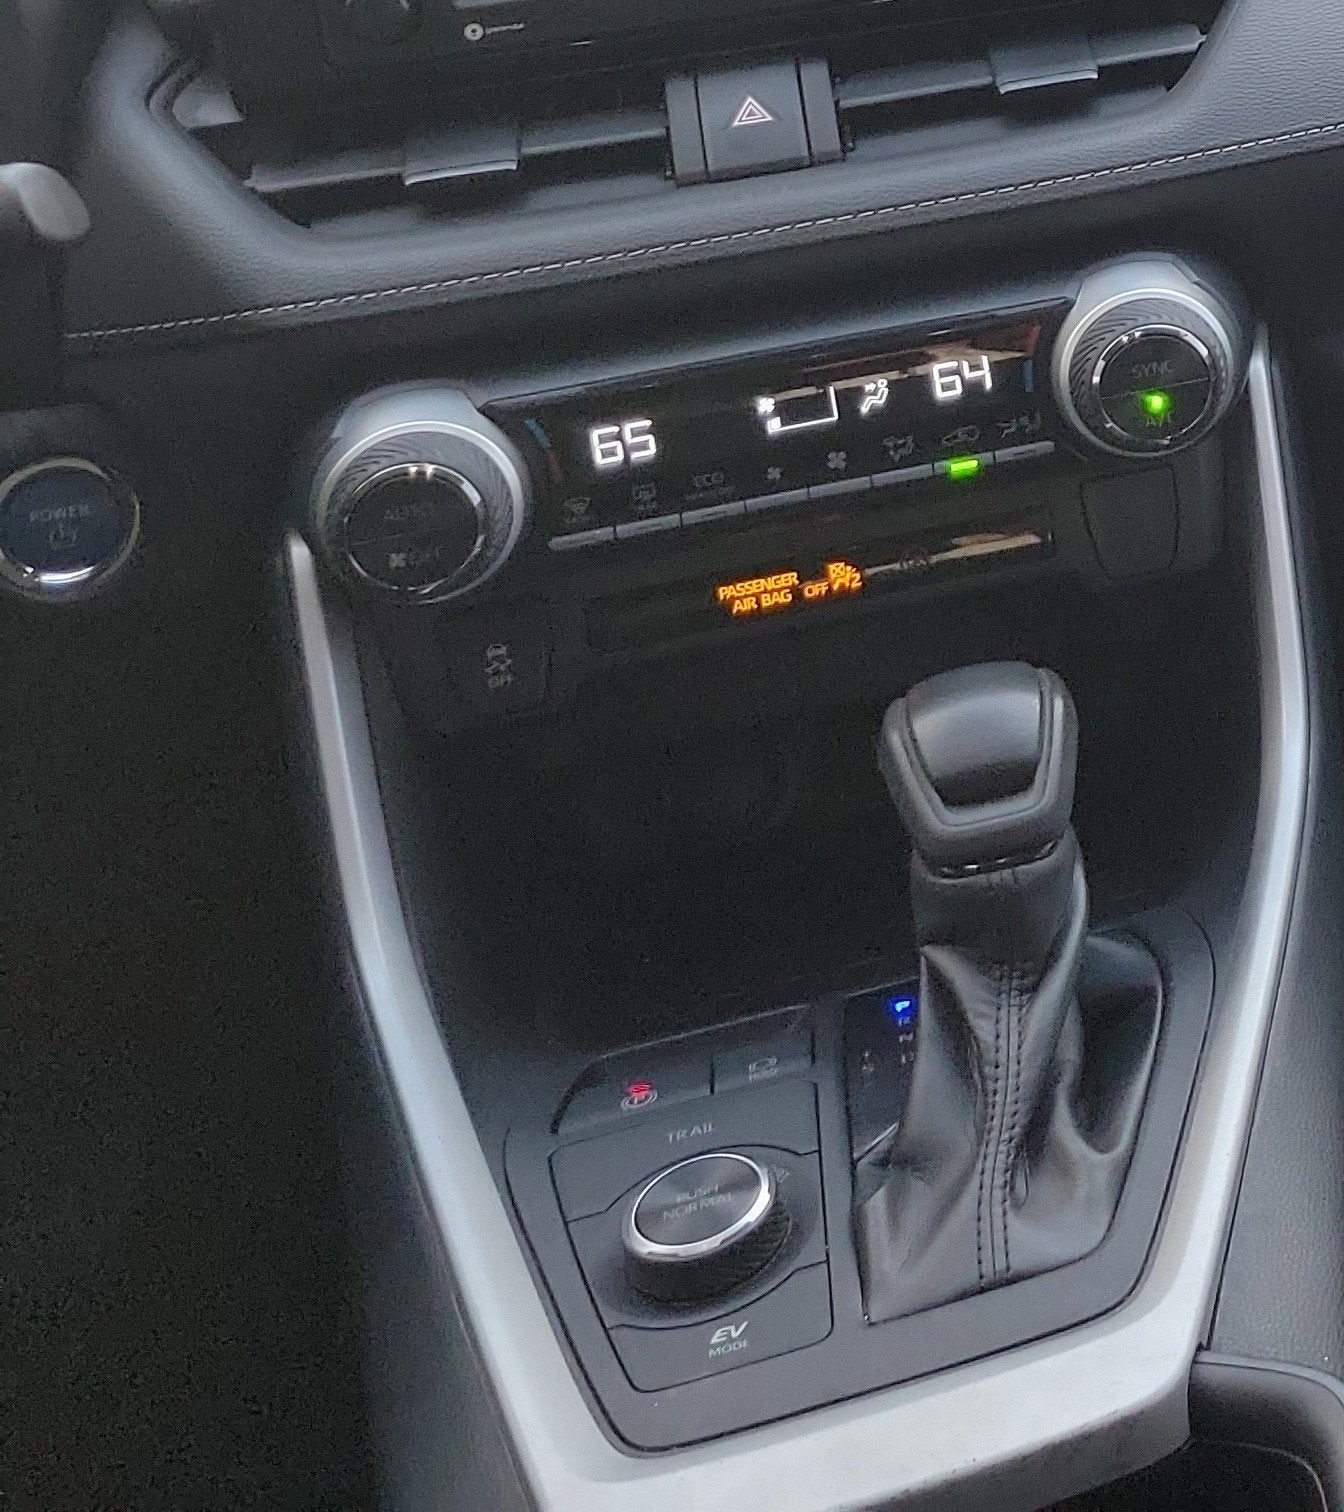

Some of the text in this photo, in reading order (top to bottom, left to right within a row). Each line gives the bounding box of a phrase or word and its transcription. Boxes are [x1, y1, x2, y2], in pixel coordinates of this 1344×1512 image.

[931, 355, 992, 400] 64
[1131, 359, 1174, 379] SYNC
[591, 418, 657, 467] 65
[718, 571, 800, 603] PASSENGER
[732, 582, 830, 615] AIR BAG OFF
[709, 1319, 749, 1345] EV
[708, 1338, 751, 1359] MODE
